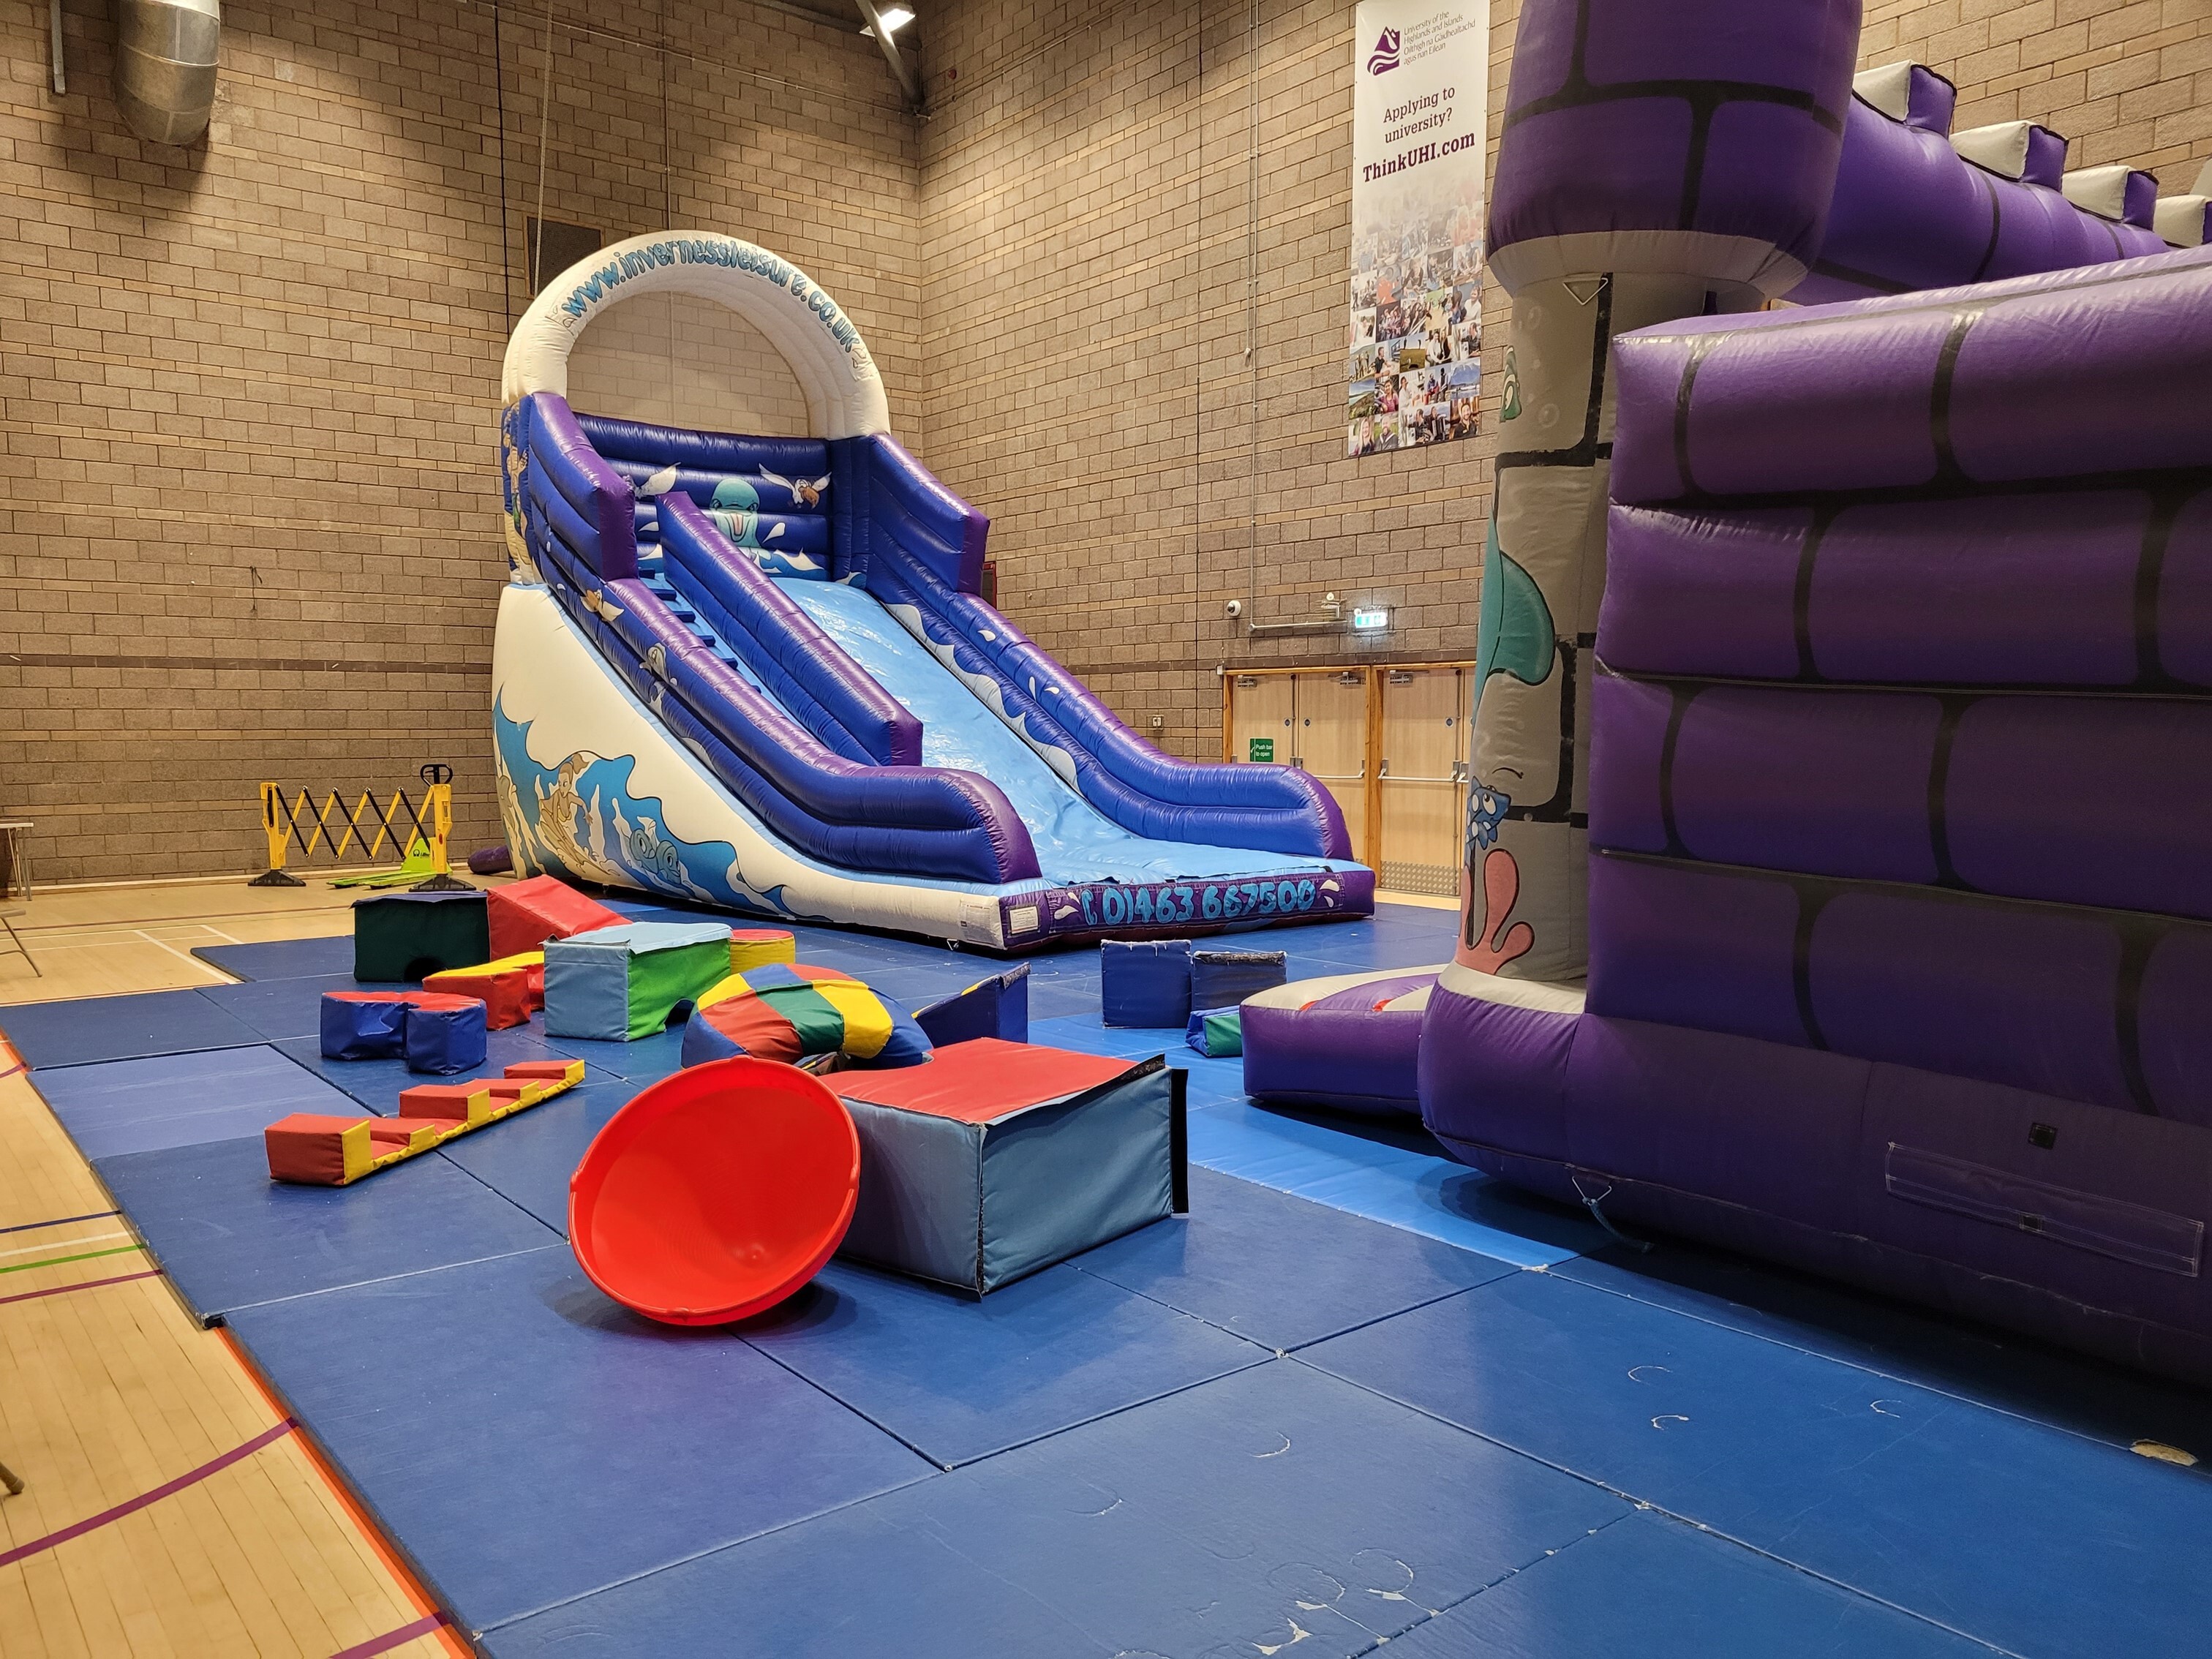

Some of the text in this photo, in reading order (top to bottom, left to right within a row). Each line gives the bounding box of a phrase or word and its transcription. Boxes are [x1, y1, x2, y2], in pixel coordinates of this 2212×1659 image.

[1404, 11, 1449, 35] University of the
[1404, 13, 1464, 45] Highlands and Islands
[1404, 40, 1426, 55] Oilthigh
[1426, 38, 1434, 46] na
[1404, 42, 1446, 66] agus nan Eilean
[1383, 87, 1455, 123] Applying to
[1385, 107, 1453, 143] university?
[1363, 132, 1475, 183] ThinkUHI.com
[561, 240, 859, 353] www.invernessleisure.co.uk
[1102, 879, 1316, 925] 01463 667500
